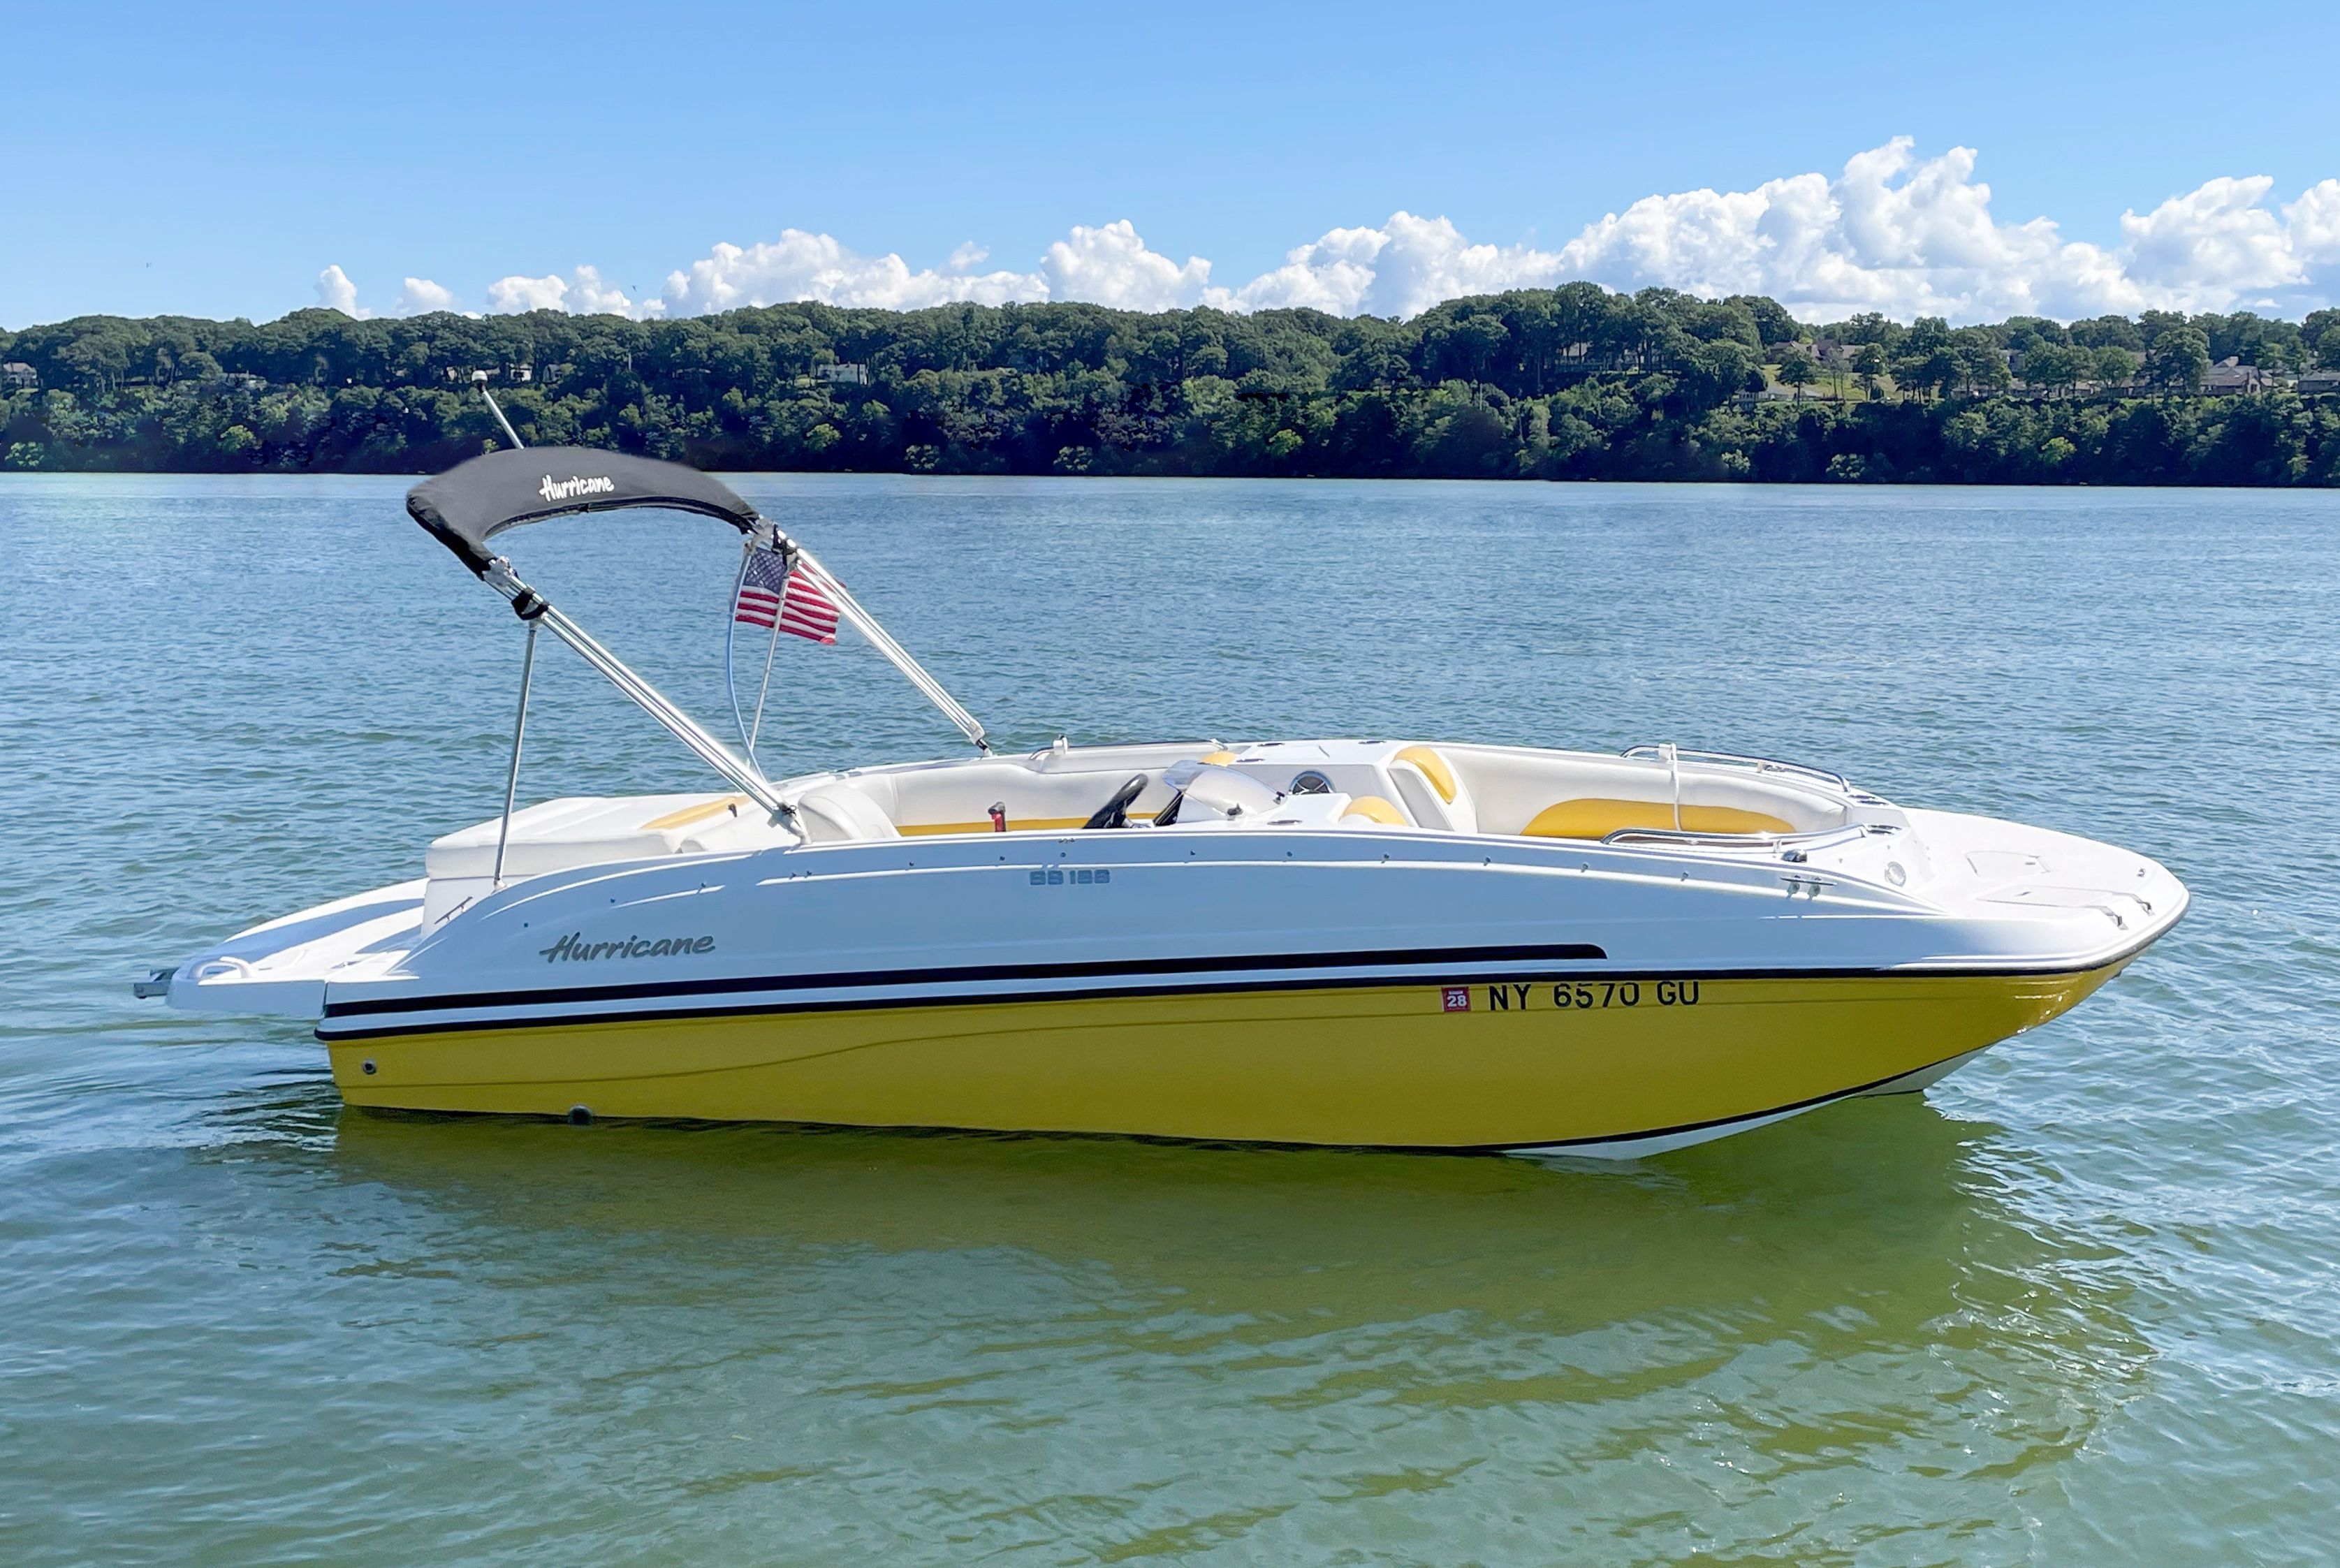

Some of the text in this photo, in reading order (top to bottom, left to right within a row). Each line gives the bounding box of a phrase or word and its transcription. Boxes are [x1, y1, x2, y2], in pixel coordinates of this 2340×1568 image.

[539, 474, 615, 501] Hurricane
[539, 931, 716, 963] Hurricane
[1447, 994, 1468, 1007] 28
[1489, 980, 1699, 1011] NY 6570 GU
